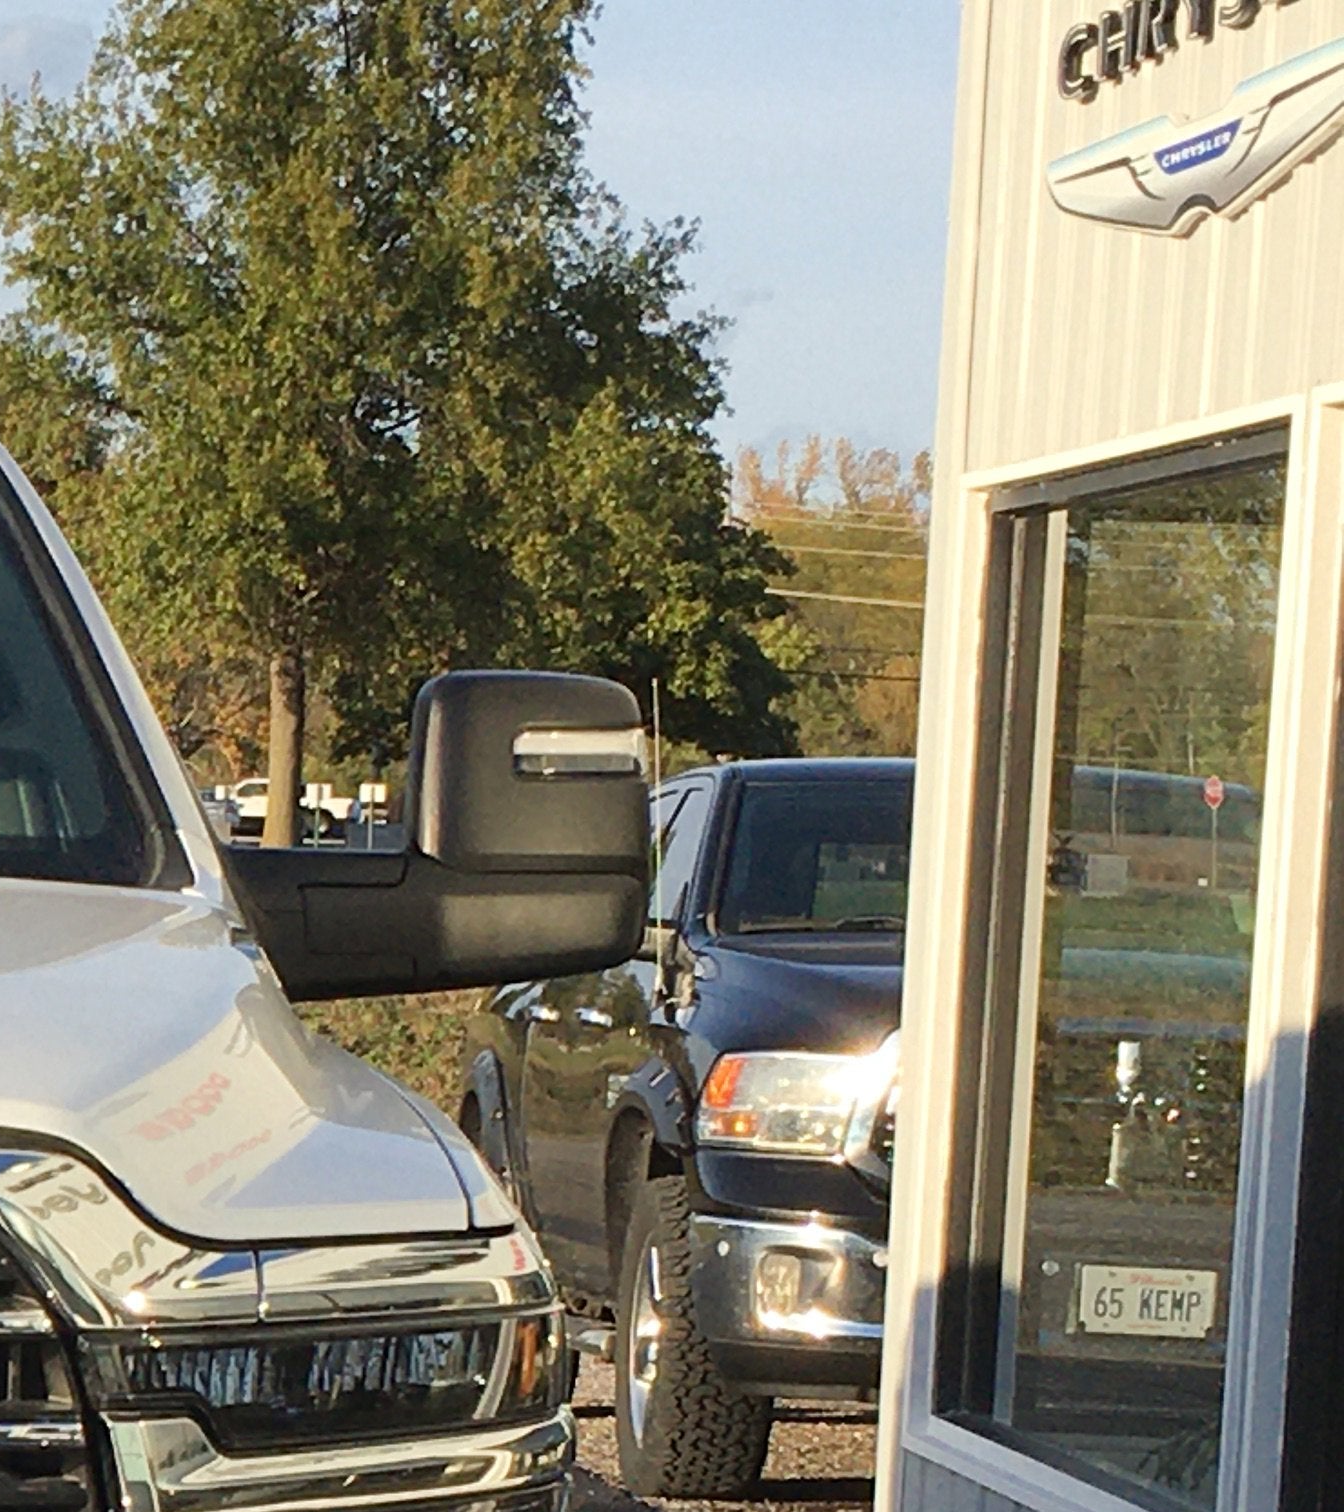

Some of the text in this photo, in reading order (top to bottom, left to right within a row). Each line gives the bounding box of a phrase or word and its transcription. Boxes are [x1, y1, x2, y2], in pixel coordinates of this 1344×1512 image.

[1161, 131, 1231, 168] CHRYSLER
[1093, 1286, 1202, 1322] 65 KEMP
